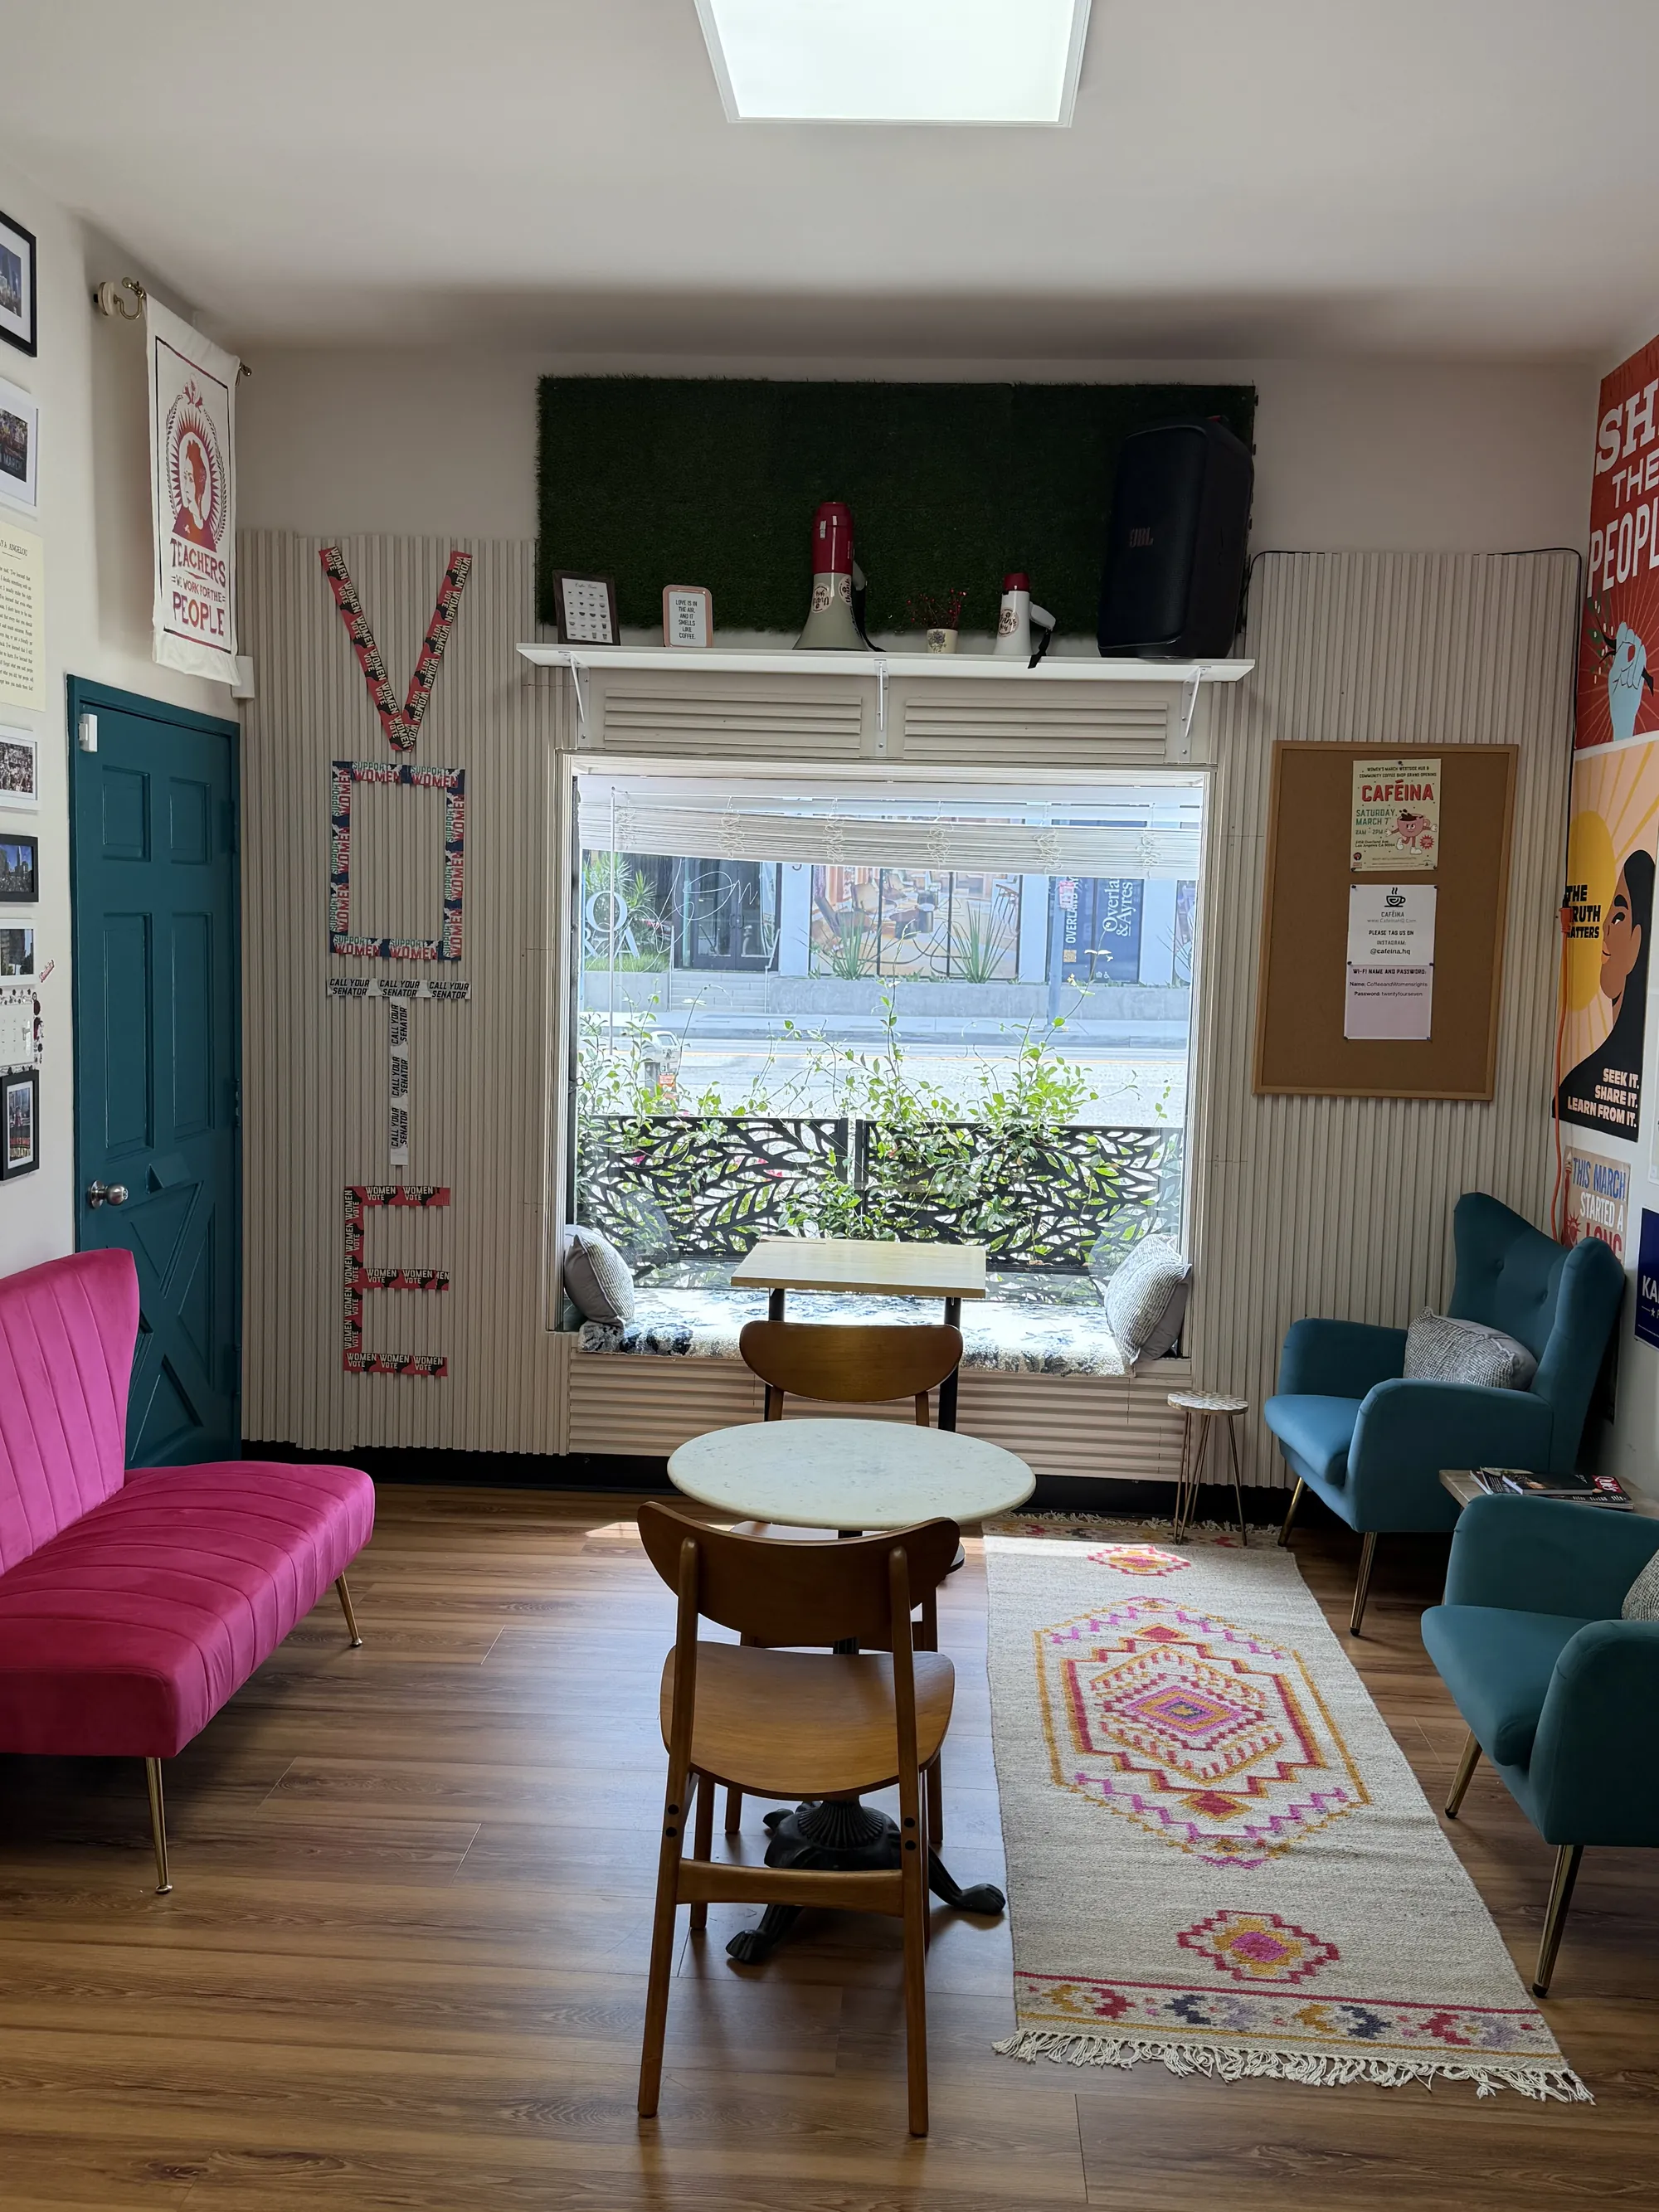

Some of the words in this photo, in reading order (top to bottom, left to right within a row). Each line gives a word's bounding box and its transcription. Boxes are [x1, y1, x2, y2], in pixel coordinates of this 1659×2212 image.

[1595, 377, 1659, 475] SH
[1613, 448, 1659, 508] THE
[1129, 527, 1154, 547] JBL
[170, 537, 226, 588] TEACHERS
[325, 552, 337, 571] VOTE
[331, 547, 348, 580] WOMEN
[452, 557, 463, 575] VOTE
[455, 557, 471, 589] WOMEN
[183, 578, 199, 594] WORK
[200, 586, 211, 598] FOR
[211, 590, 221, 602] THE
[338, 586, 349, 604] VOTE
[344, 581, 361, 613] WOMEN
[441, 591, 452, 608] VOTE
[173, 591, 225, 636] PEOPLE
[445, 591, 460, 622] WOMEN
[351, 620, 362, 639] VOTE
[357, 615, 374, 648] WOMEN
[431, 624, 442, 642] VOTE
[435, 625, 450, 656] WOMEN
[364, 653, 374, 672] VOTE
[371, 649, 386, 681] WOMEN
[420, 657, 431, 675] VOTE
[424, 658, 440, 689] WOMEN
[375, 687, 386, 706] VOTE
[382, 682, 399, 715] WOMEN
[410, 691, 421, 707] VOTE
[412, 691, 429, 722] WOMEN
[388, 720, 399, 739] VOTE
[396, 715, 411, 749] WOMEN
[353, 770, 401, 784] WOMEN
[411, 774, 458, 789] WOMEN
[339, 768, 350, 815] WOMEN
[1362, 779, 1433, 802] CAFÉINA
[453, 795, 465, 843] WOMEN
[338, 826, 350, 873] WOMEN
[452, 851, 464, 901] WOMEN
[1566, 885, 1588, 902] THE
[337, 882, 349, 932] WOMEN
[1570, 905, 1601, 922] RUTH
[450, 909, 462, 957] WOMEN
[334, 943, 381, 956] WOMEN
[389, 946, 437, 960] WOMEN
[382, 989, 417, 997] SENATOR
[392, 1079, 400, 1096] CALL
[1603, 1068, 1627, 1087] SEEK
[1629, 1072, 1639, 1089] IT.
[1594, 1085, 1626, 1106] SHARE
[1627, 1092, 1637, 1108] IT.
[1568, 1096, 1596, 1116] LEARN
[1598, 1104, 1625, 1124] FROM
[1627, 1111, 1637, 1127] IT.
[400, 1111, 408, 1145] SENATOR
[366, 1186, 396, 1194] WOMEN
[402, 1186, 433, 1194] WOMEN
[1573, 1157, 1591, 1189] THIS
[1593, 1164, 1626, 1201] MARCH
[344, 1190, 353, 1221] WOMEN
[1580, 1191, 1615, 1229] STARTED
[1617, 1204, 1623, 1232] A
[344, 1255, 353, 1285] WOMEN
[367, 1269, 397, 1277] WOMEN
[402, 1270, 432, 1278] WOMEN
[1642, 1275, 1659, 1304] KA
[344, 1287, 353, 1317] WOMEN
[347, 1353, 377, 1361] WOMEN
[379, 1354, 410, 1363] WOMEN
[414, 1356, 443, 1365] WOMEN
